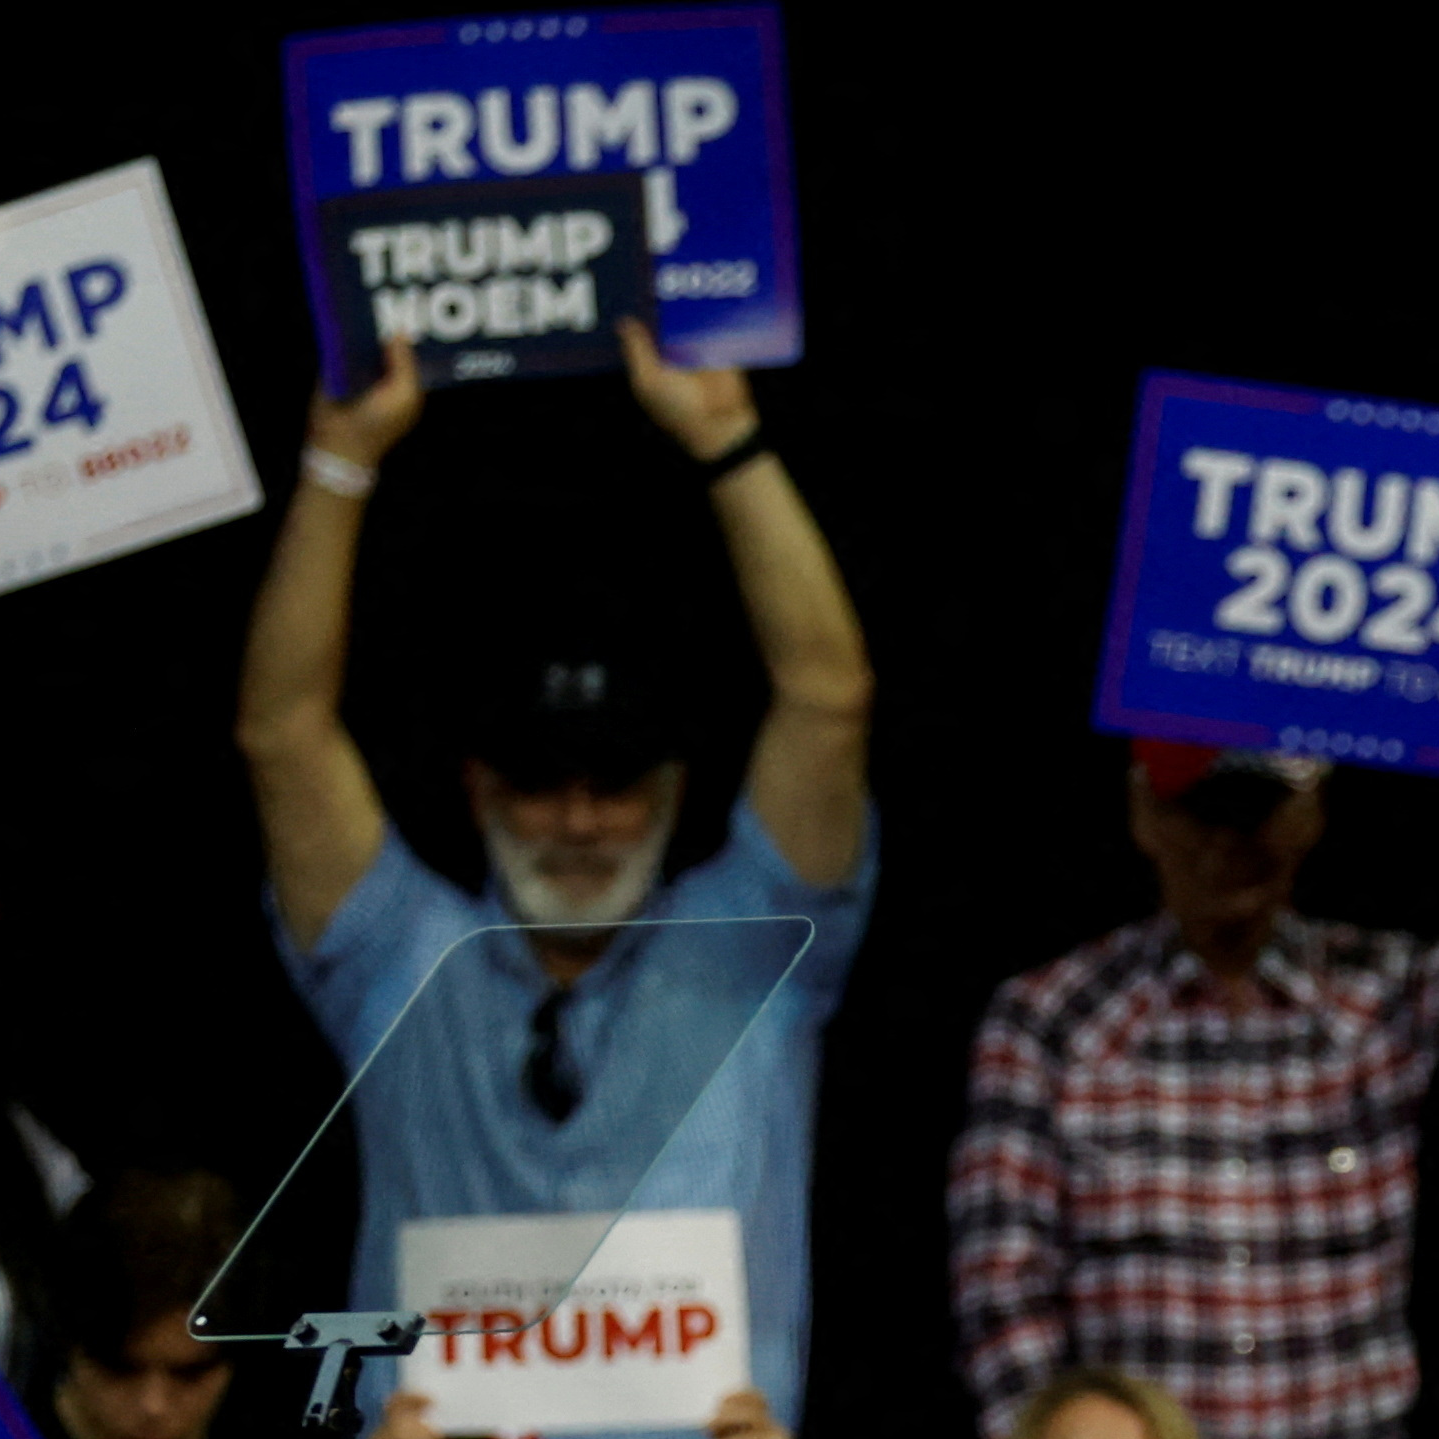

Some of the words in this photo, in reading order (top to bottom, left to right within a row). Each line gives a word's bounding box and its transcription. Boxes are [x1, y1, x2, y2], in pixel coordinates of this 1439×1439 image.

[329, 76, 739, 187] TRUMP
[350, 209, 614, 289] TRUMP
[373, 270, 599, 346] NOEM
[1248, 642, 1383, 693] TRUMP
[427, 1302, 718, 1368] TRUMP
